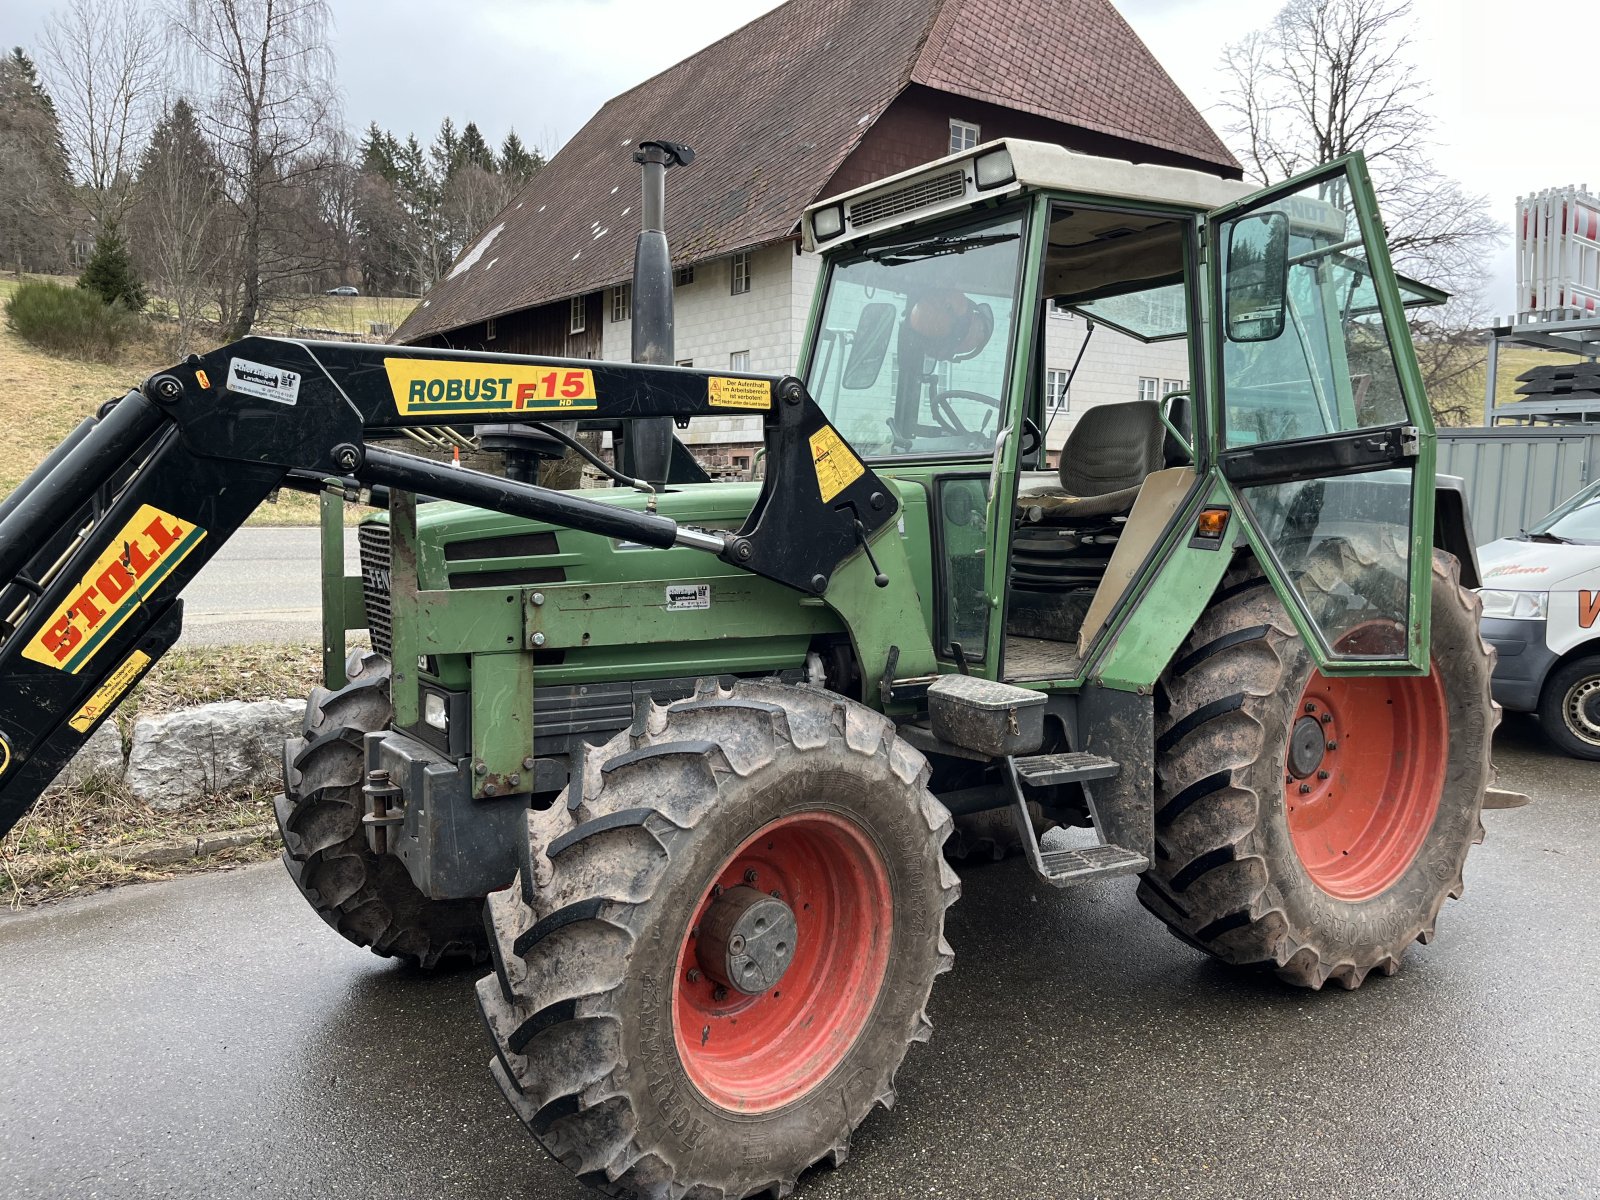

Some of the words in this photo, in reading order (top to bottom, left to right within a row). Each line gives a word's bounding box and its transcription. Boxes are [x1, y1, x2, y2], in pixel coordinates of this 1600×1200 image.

[408, 378, 513, 402] ROBUST
[730, 387, 769, 395] Arbeitsbereich
[40, 515, 184, 662] STOLL
[369, 568, 390, 591] FEN
[639, 970, 709, 1150] AGRIMAX
